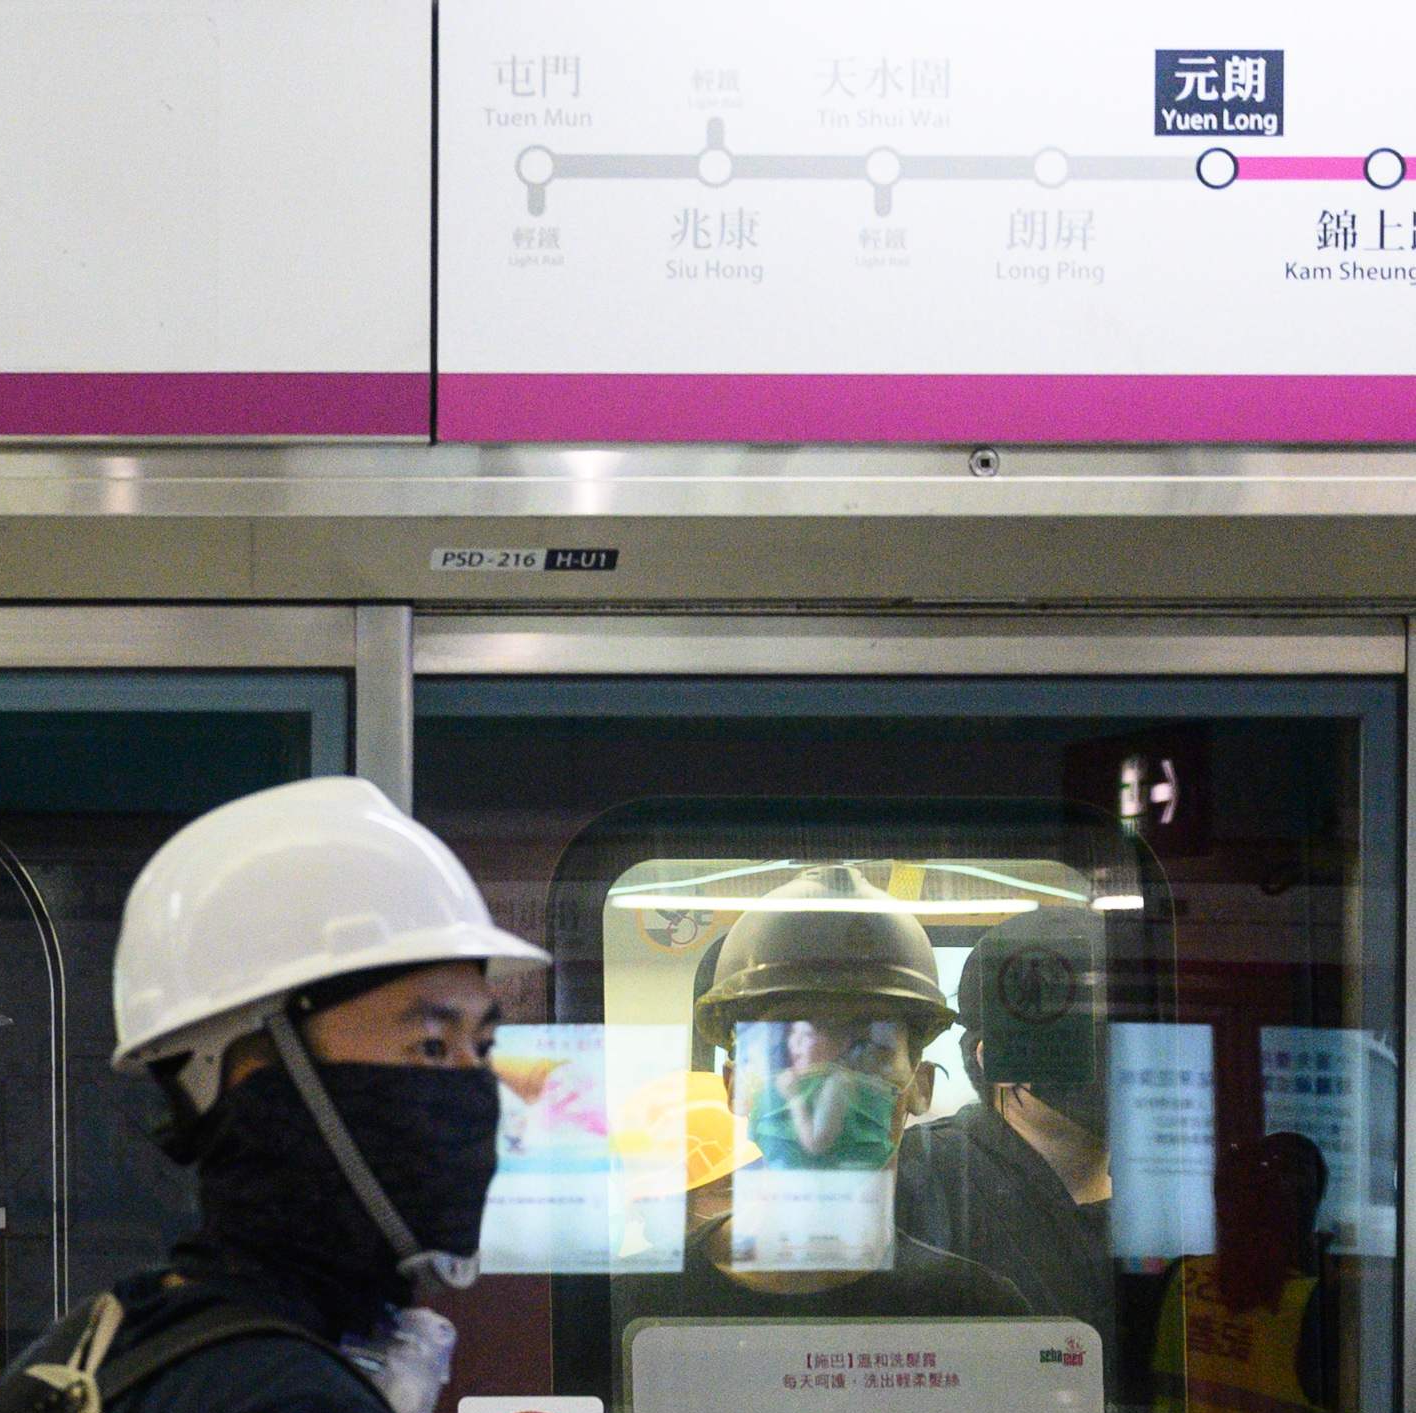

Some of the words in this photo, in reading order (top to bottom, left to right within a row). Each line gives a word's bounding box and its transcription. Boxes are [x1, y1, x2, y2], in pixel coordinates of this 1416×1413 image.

[490, 54, 583, 99] 屯門
[816, 57, 952, 99] 天水圍
[1174, 56, 1267, 103] 元朗
[483, 107, 538, 129] Tuen
[544, 107, 593, 128] Mun
[817, 109, 852, 129] Tin
[857, 108, 905, 129] Shui
[909, 109, 952, 129] Wai
[1161, 108, 1217, 131] Yuen
[1222, 108, 1279, 136] Long
[670, 206, 761, 251] 兆康
[1005, 208, 1096, 252] 朗屏
[666, 259, 697, 281] Siu
[704, 259, 763, 284] Hong
[995, 262, 1051, 284] Long
[1058, 261, 1106, 285] Ping
[1285, 262, 1332, 281] Kam
[1338, 260, 1416, 286] Sheung
[556, 551, 607, 568] H-U1
